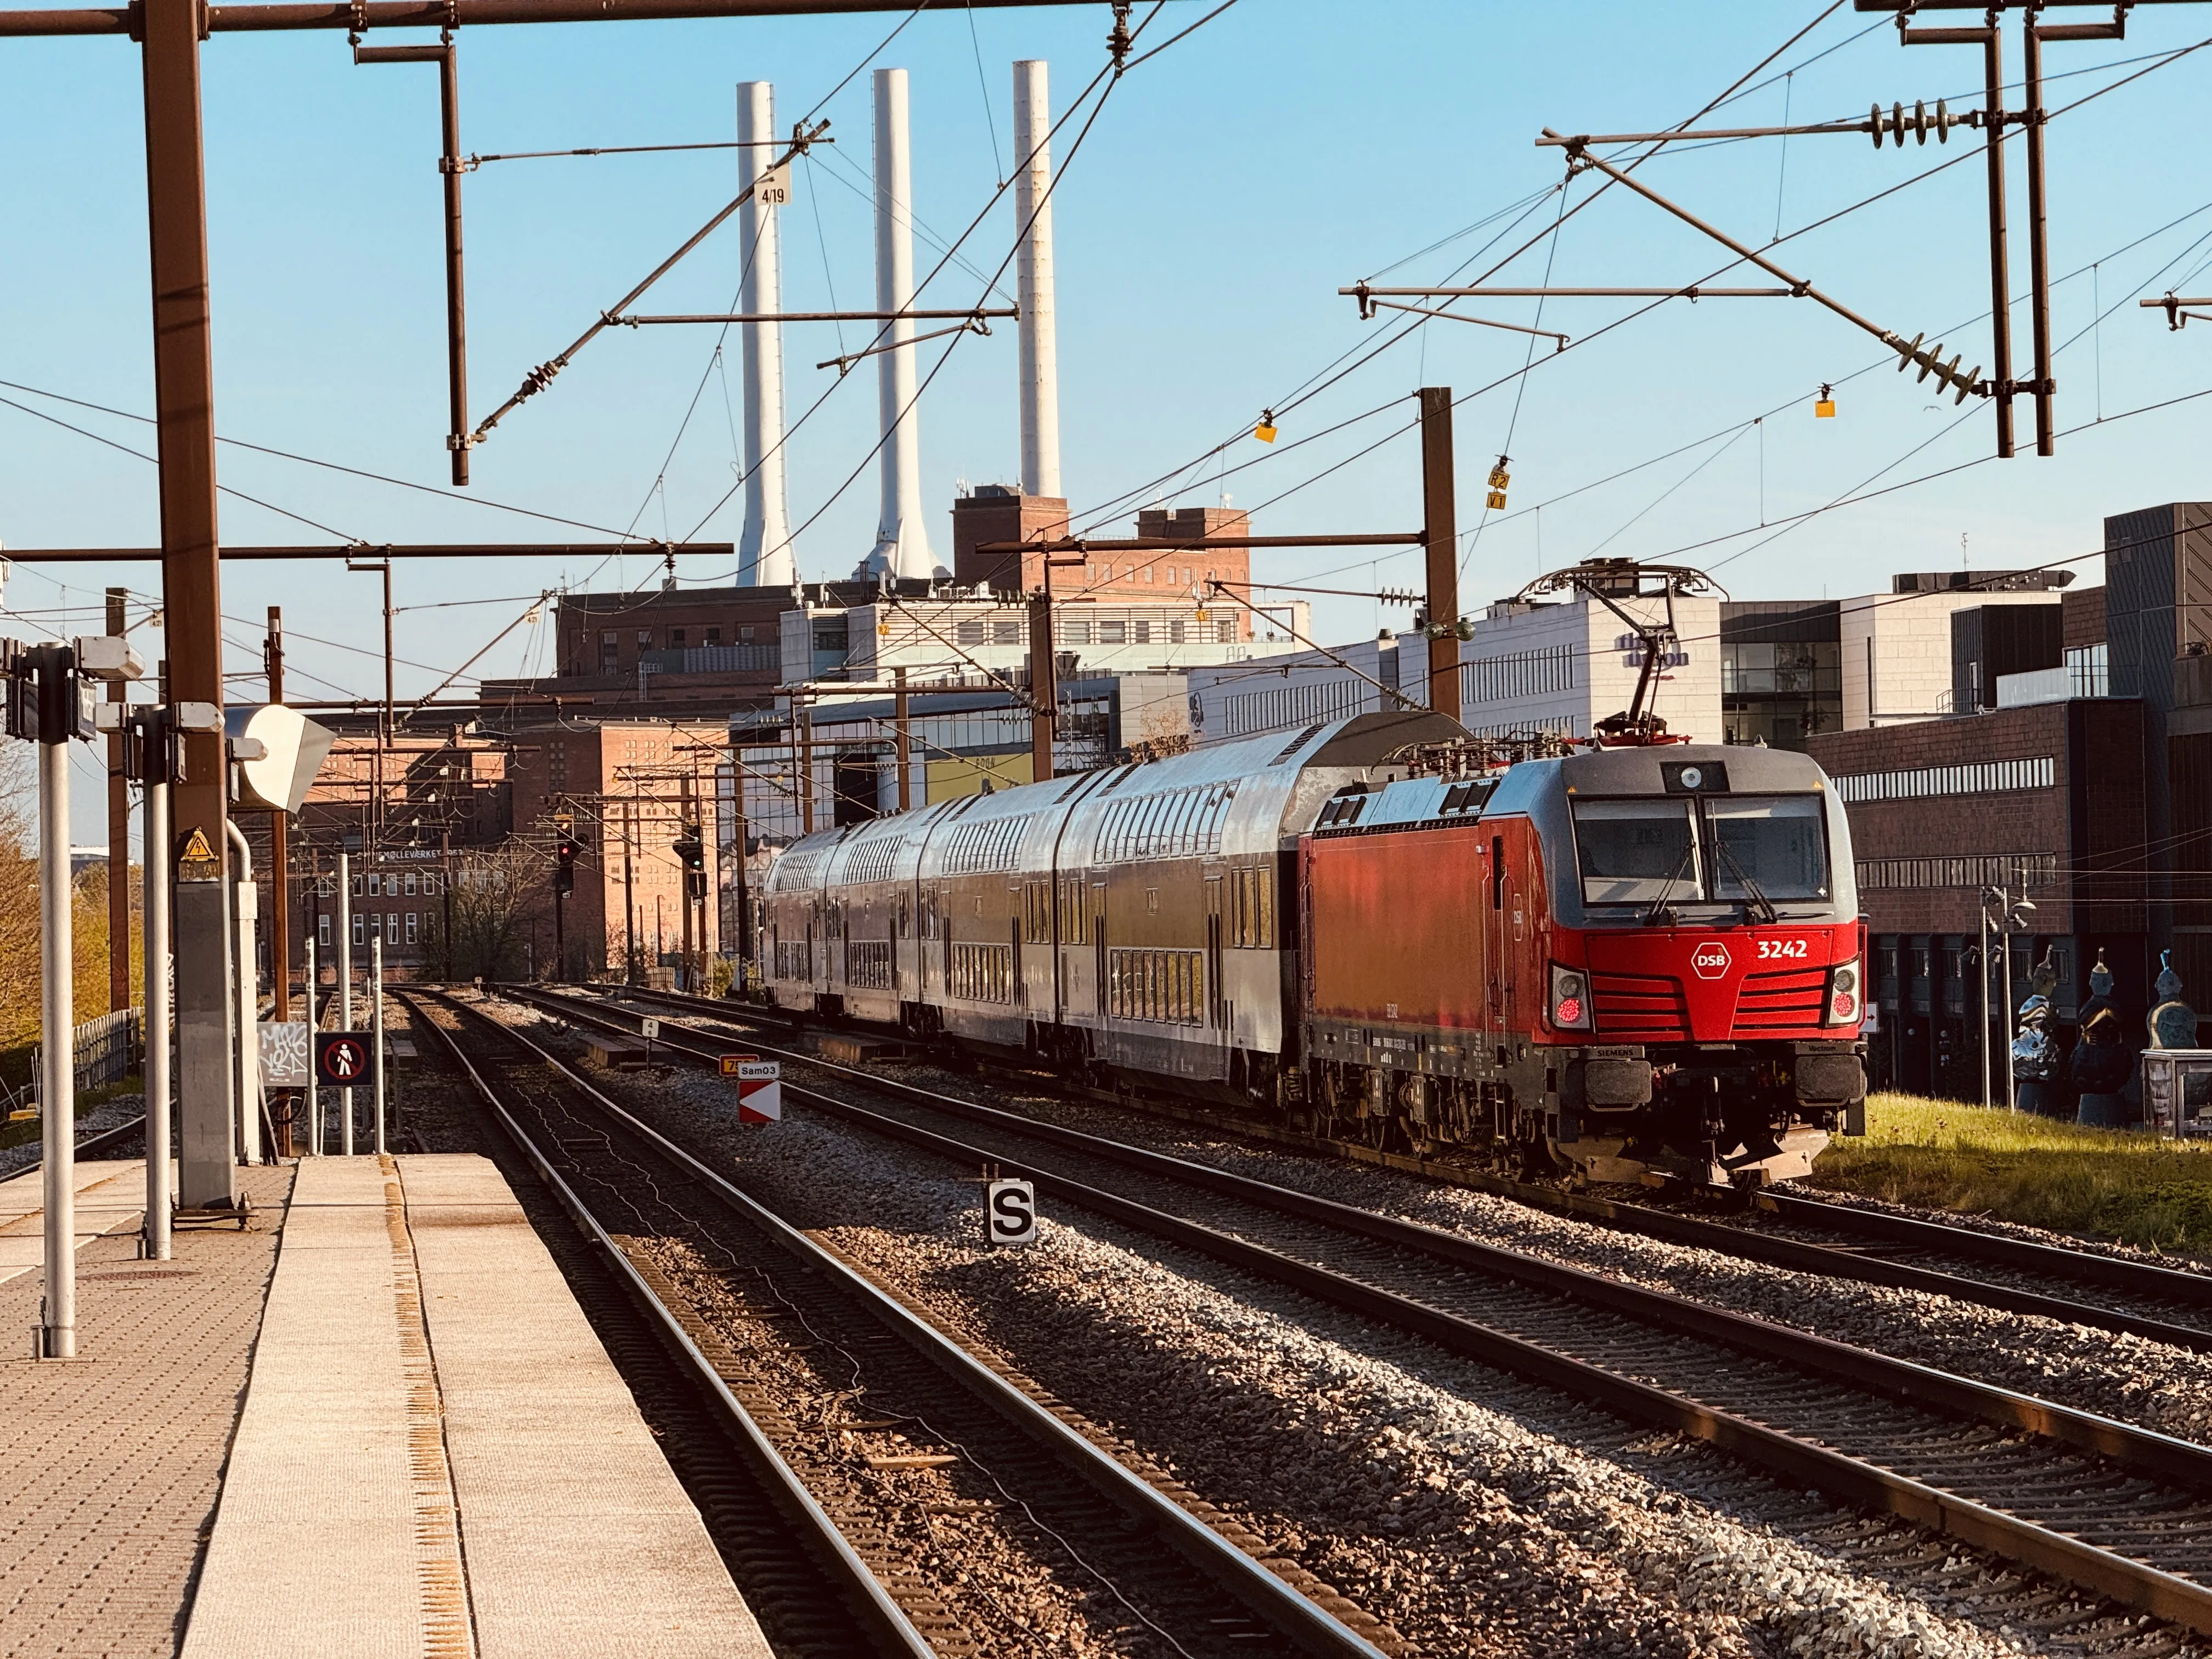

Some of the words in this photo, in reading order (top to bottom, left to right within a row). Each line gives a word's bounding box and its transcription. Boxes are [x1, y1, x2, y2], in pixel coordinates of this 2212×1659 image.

[761, 188, 785, 204] 4/19
[1757, 940, 1808, 959] 3242
[1697, 955, 1725, 967] DSB
[741, 1066, 776, 1075] Sam03
[993, 1188, 1032, 1237] S
